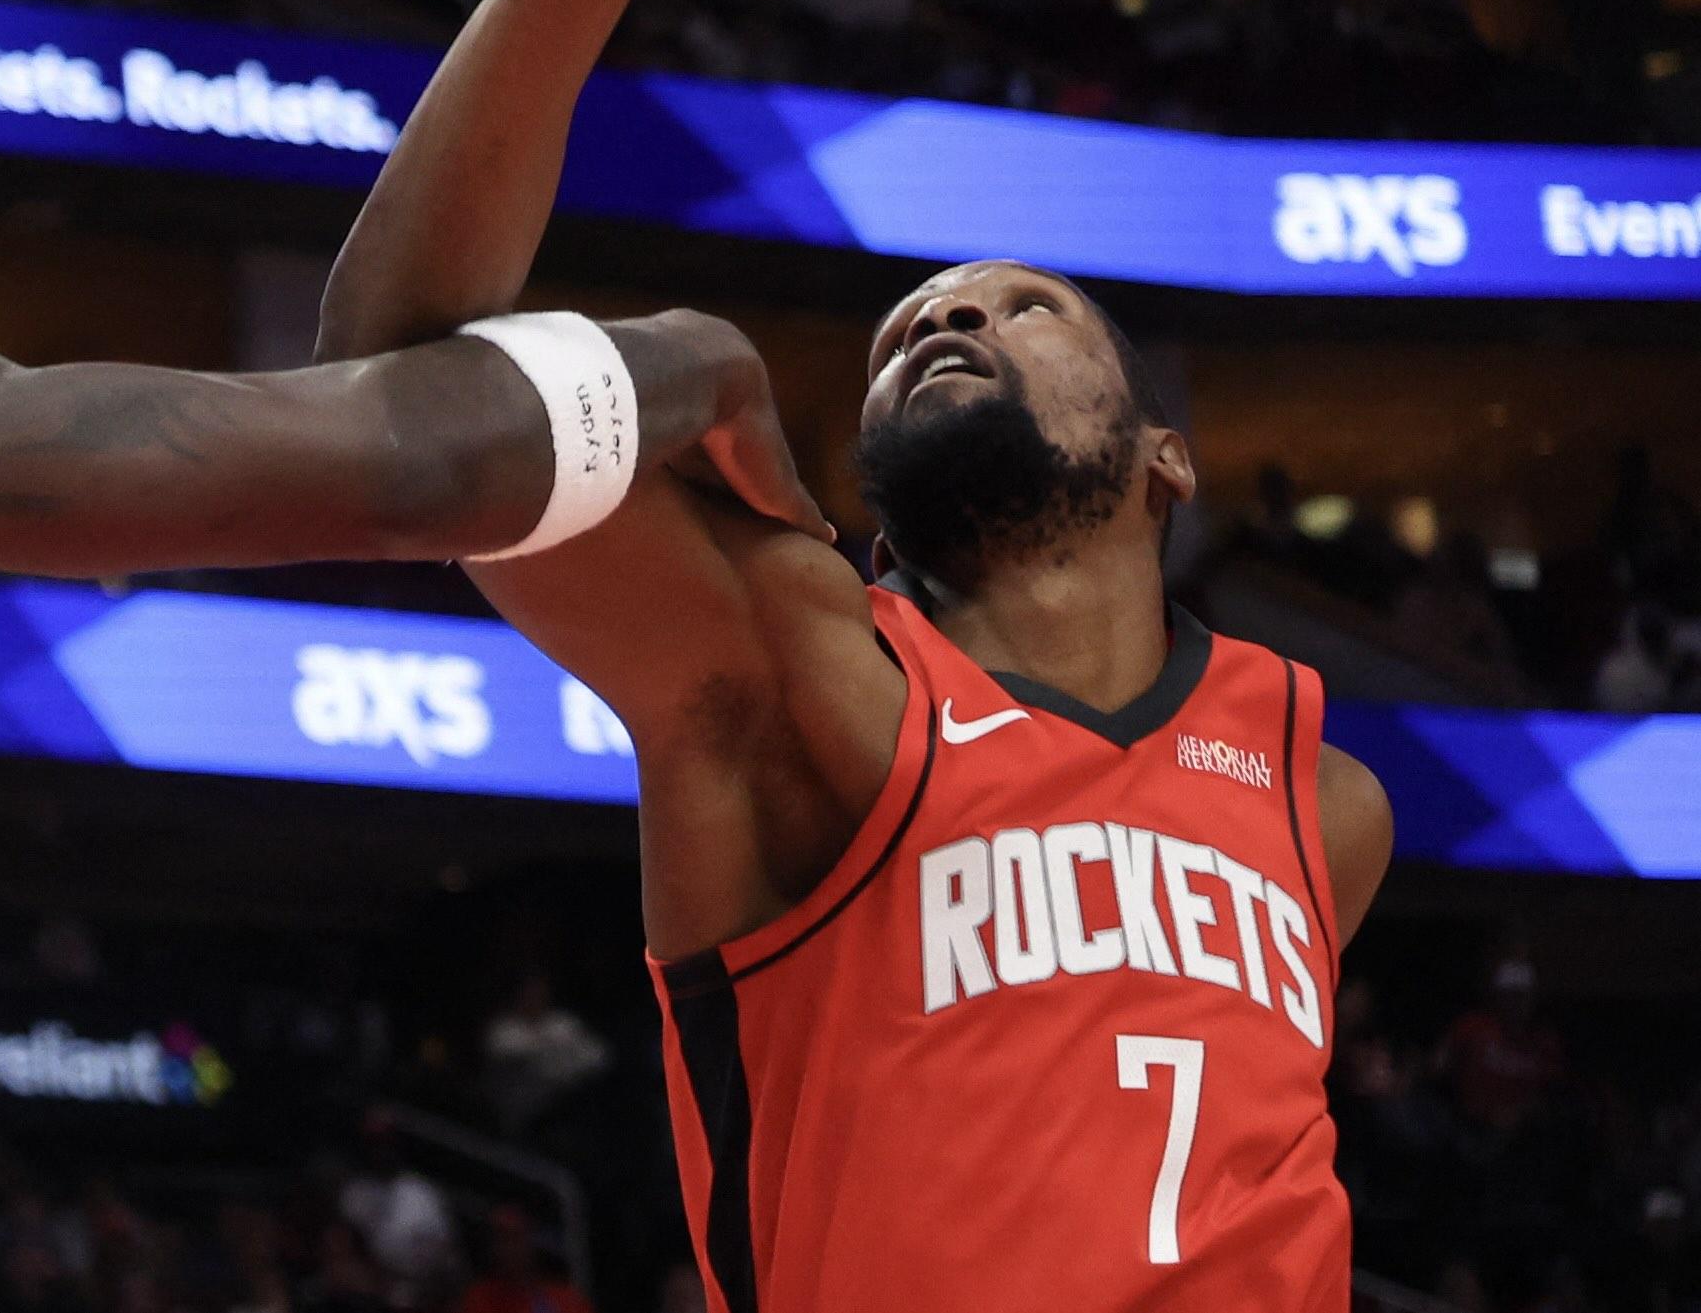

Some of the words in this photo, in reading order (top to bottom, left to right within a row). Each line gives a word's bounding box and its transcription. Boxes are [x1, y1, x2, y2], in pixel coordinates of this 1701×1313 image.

[122, 48, 400, 155] Rockets.
[1274, 172, 1467, 278] axs
[1540, 184, 1701, 258] Even
[293, 642, 490, 766] axs
[918, 821, 1326, 1050] ROCKETS
[1114, 1034, 1205, 1264] 7
